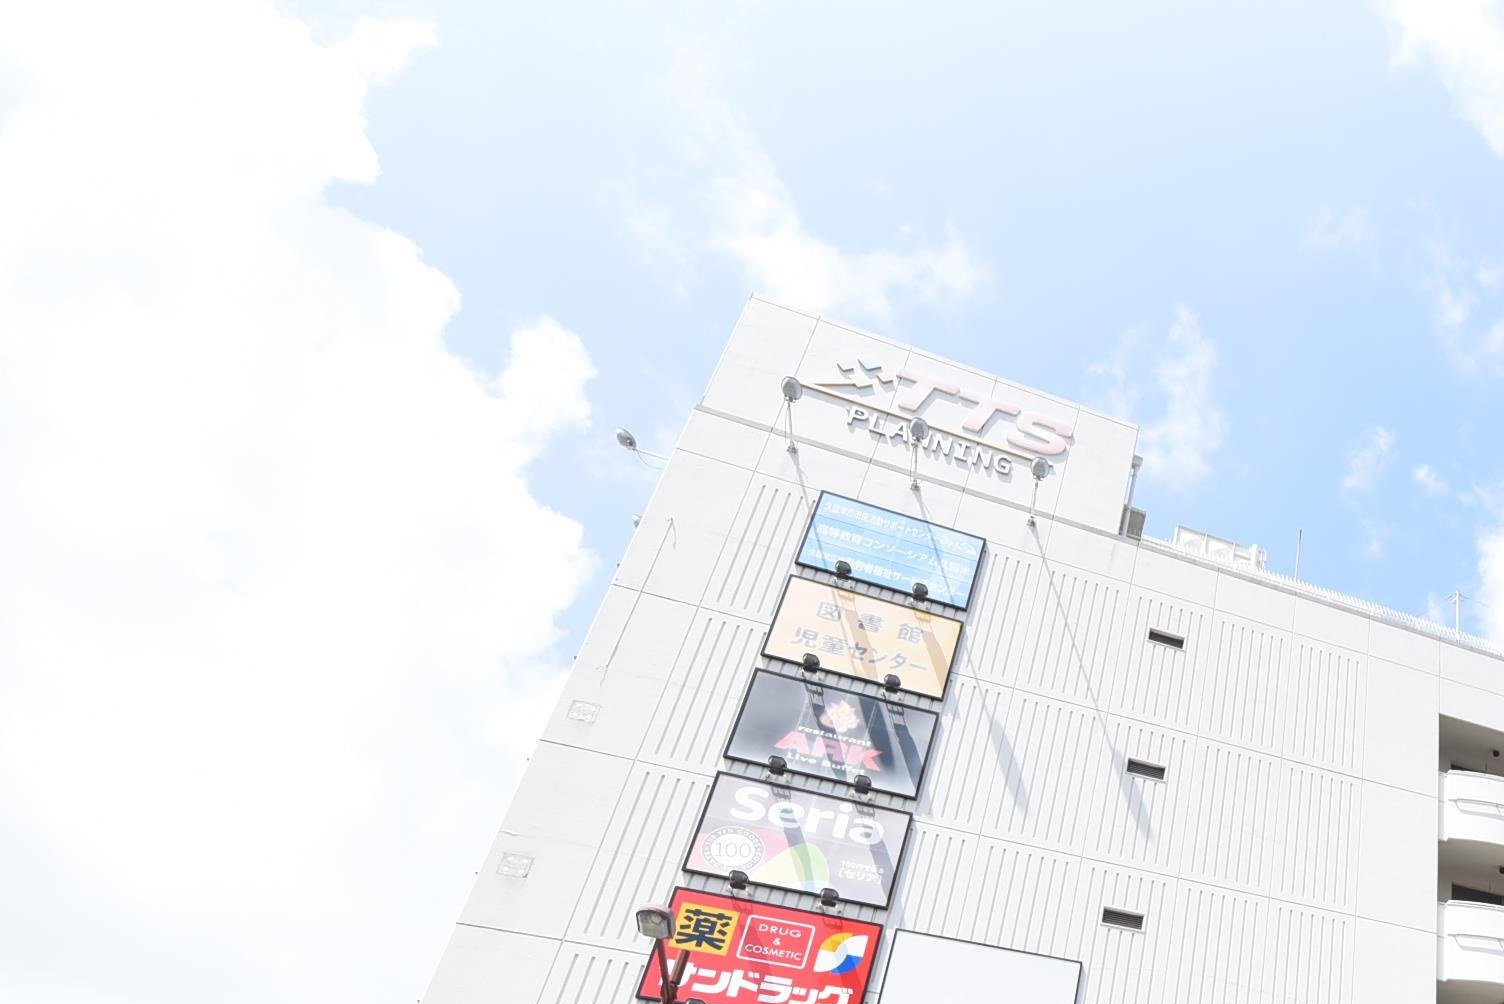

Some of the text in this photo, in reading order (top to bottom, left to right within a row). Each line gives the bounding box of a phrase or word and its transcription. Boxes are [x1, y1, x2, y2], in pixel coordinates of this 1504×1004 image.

[895, 370, 1074, 457] TTS
[816, 600, 924, 644] 図書館
[788, 625, 929, 671] 児童センター
[773, 729, 884, 772] ARK
[797, 724, 874, 747] restaurant
[786, 750, 819, 765] Live
[729, 785, 884, 846] Seria
[714, 841, 752, 858] 100
[674, 907, 734, 952] 薬
[758, 922, 802, 939] DRUG
[772, 937, 781, 946] &
[744, 942, 803, 962] COSMETIC
